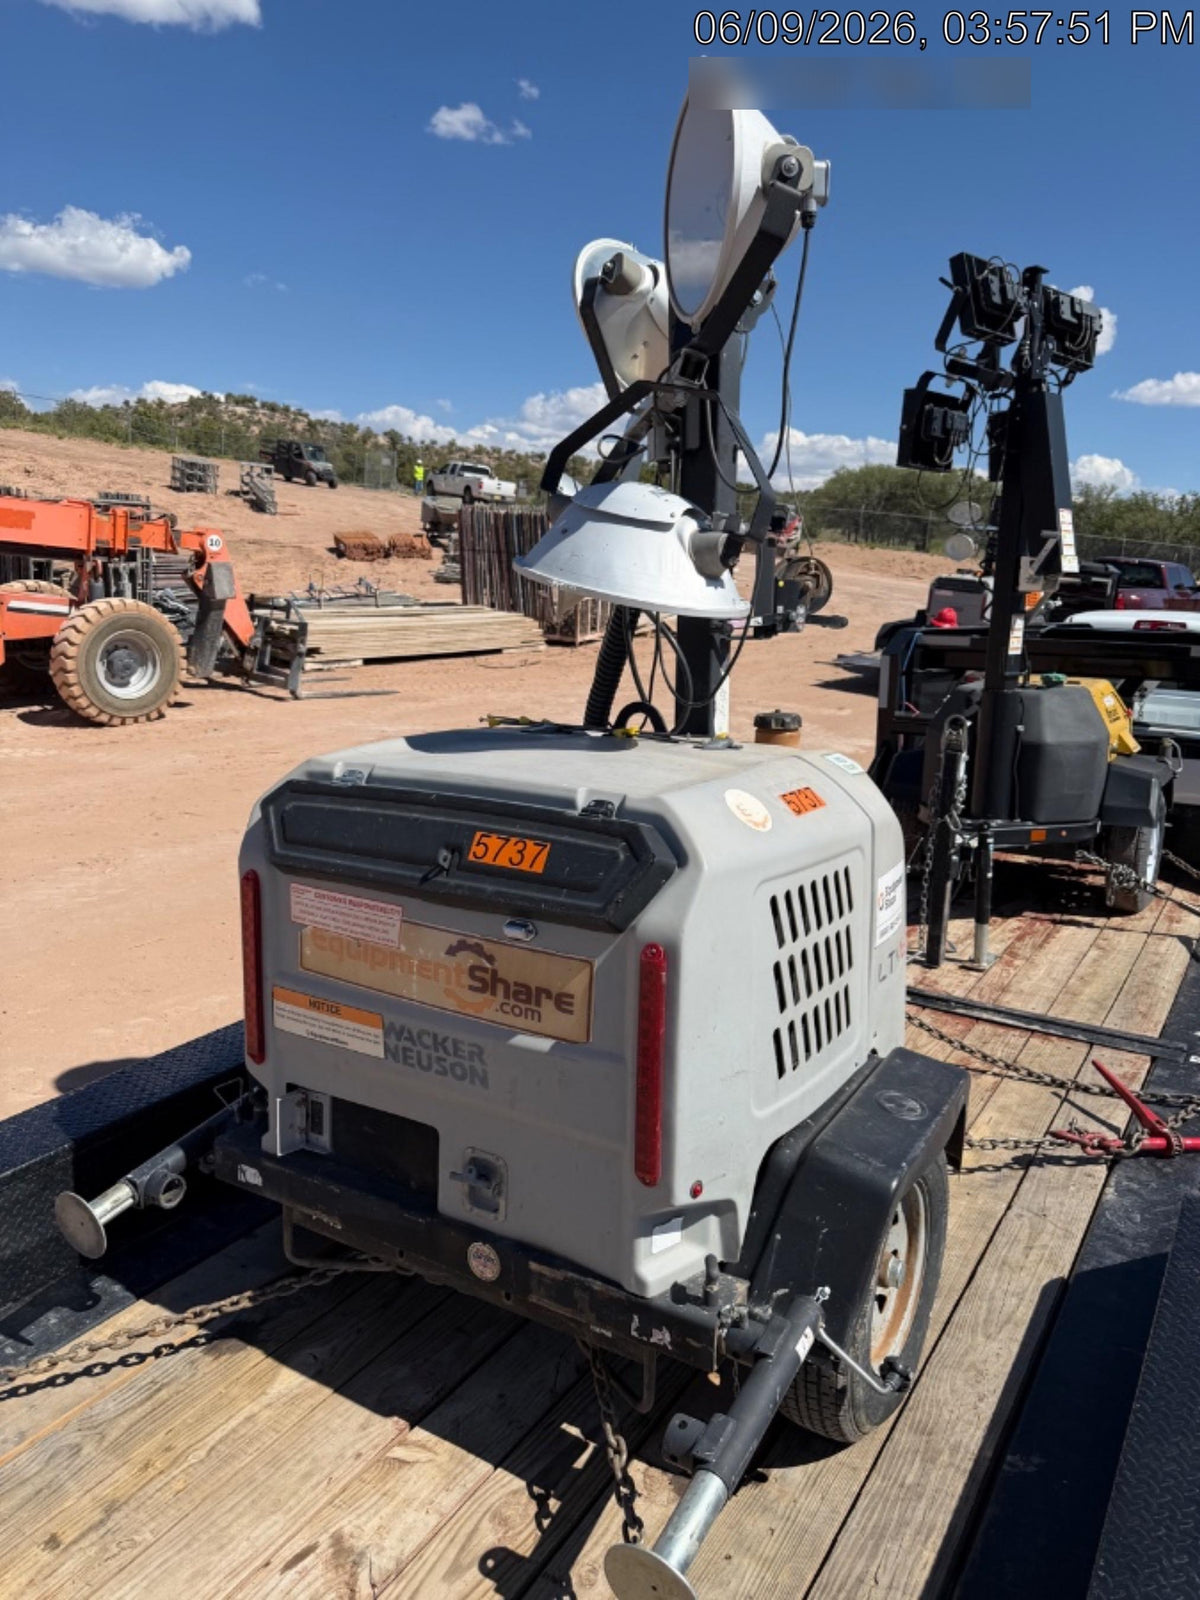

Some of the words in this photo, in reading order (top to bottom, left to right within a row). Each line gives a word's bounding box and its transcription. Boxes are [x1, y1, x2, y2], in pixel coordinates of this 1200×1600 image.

[209, 538, 221, 549] 10
[472, 833, 548, 869] 5737
[308, 998, 342, 1016] NOTICE
[495, 1001, 542, 1024] .com
[384, 1043, 490, 1091] NEUSON
